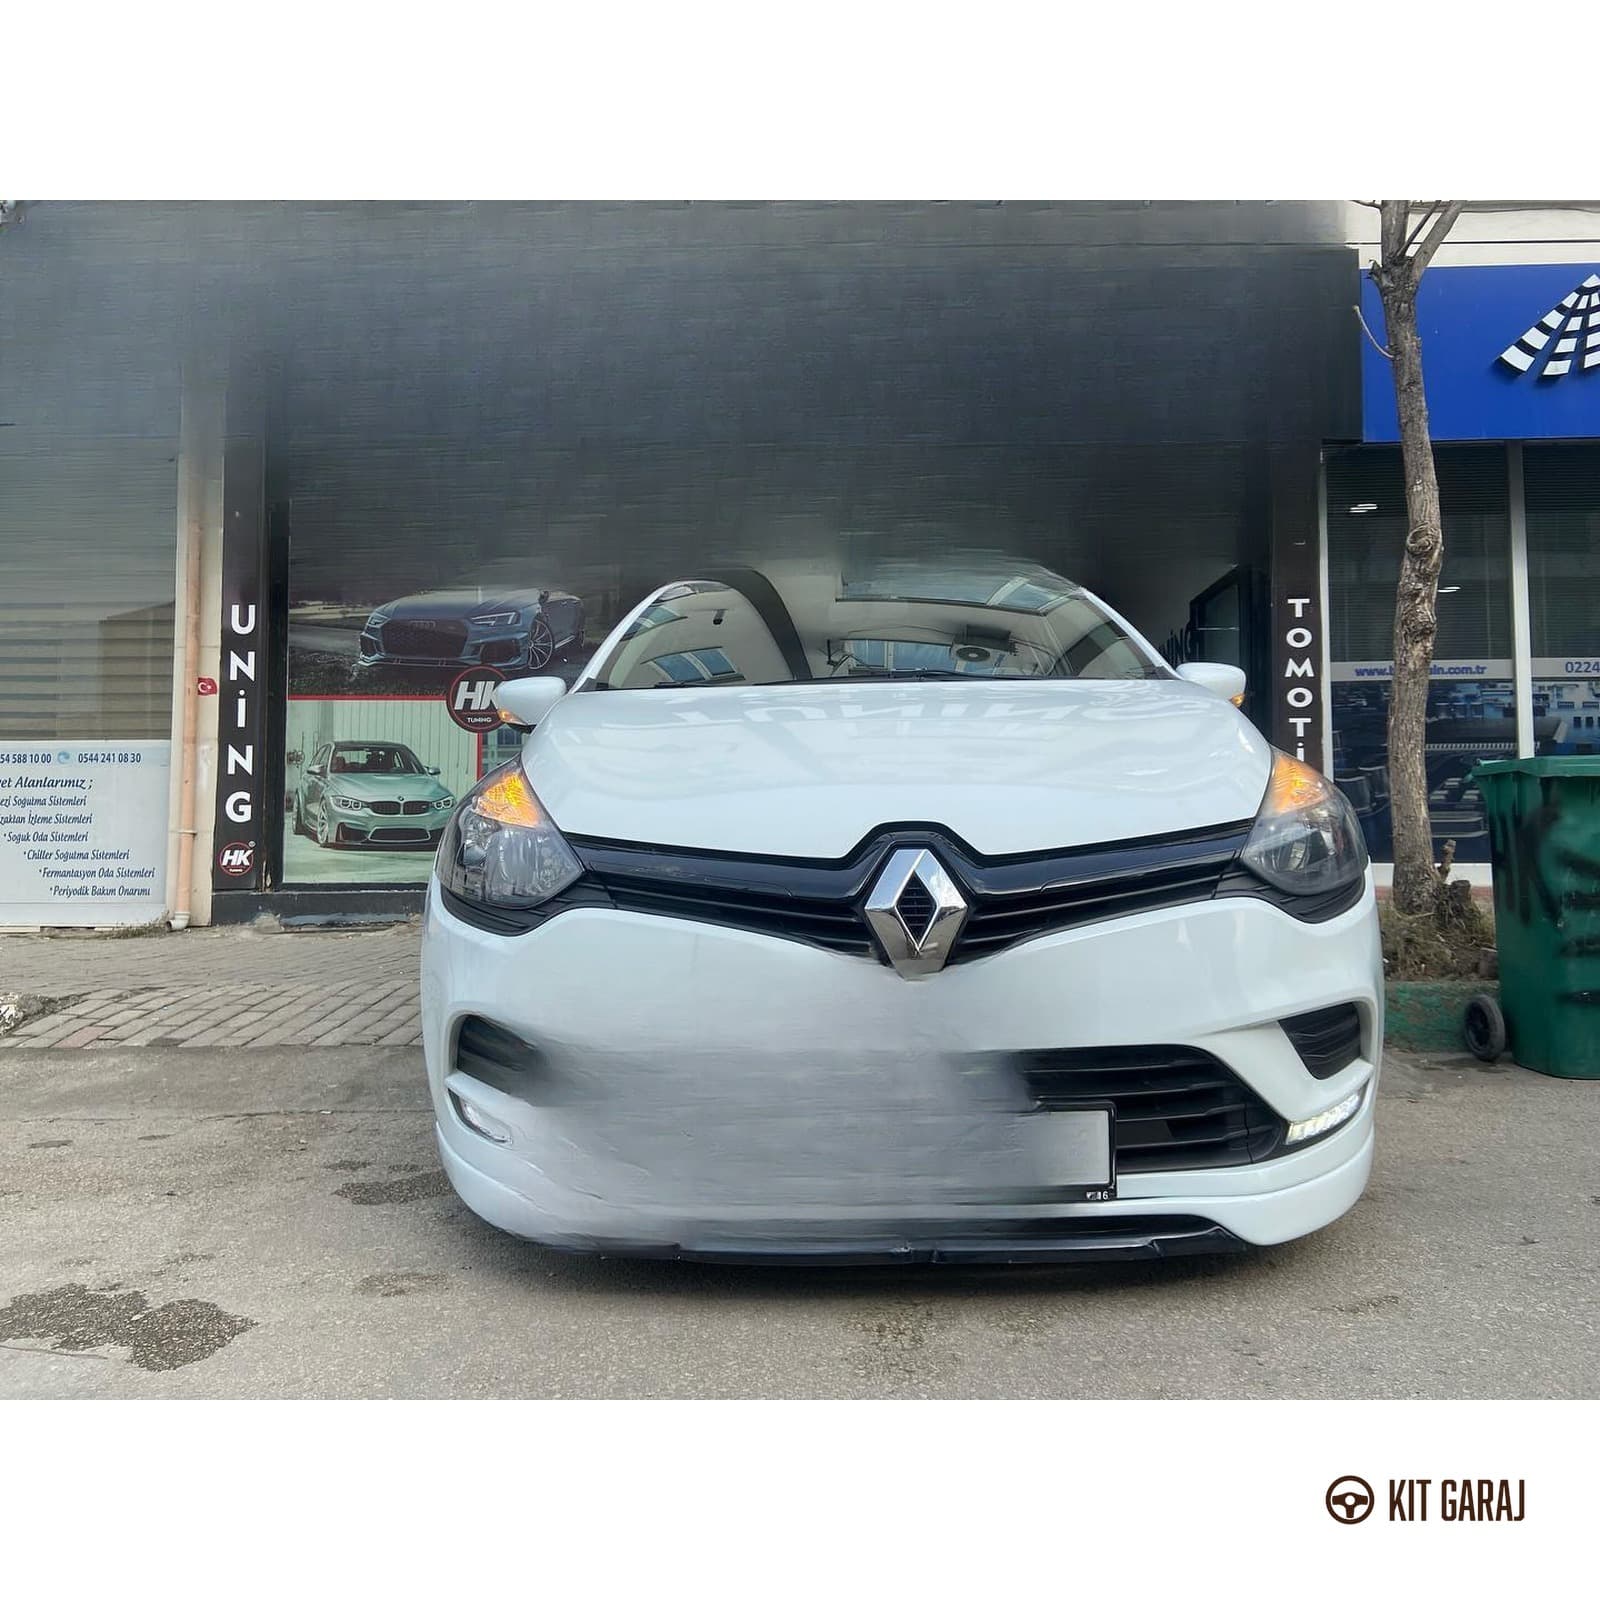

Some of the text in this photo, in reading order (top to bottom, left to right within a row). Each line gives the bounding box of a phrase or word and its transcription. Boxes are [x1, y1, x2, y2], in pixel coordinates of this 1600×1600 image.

[1565, 661, 1600, 673] 0224
[454, 680, 499, 710] HK
[12, 753, 27, 764] 588
[78, 753, 142, 764] 0544 241 08 30
[48, 795, 87, 806] Sistemleri
[54, 813, 93, 824] Sistemleri
[32, 831, 49, 842] Oda
[50, 831, 89, 842] Sistemleri
[27, 849, 53, 860] Chiller
[91, 849, 130, 860] Sistemleri
[222, 850, 253, 866] HK
[42, 867, 155, 880] Fermantasyon Oda Sistemleri
[53, 885, 90, 898] Periyodik
[91, 885, 116, 896] Bakım
